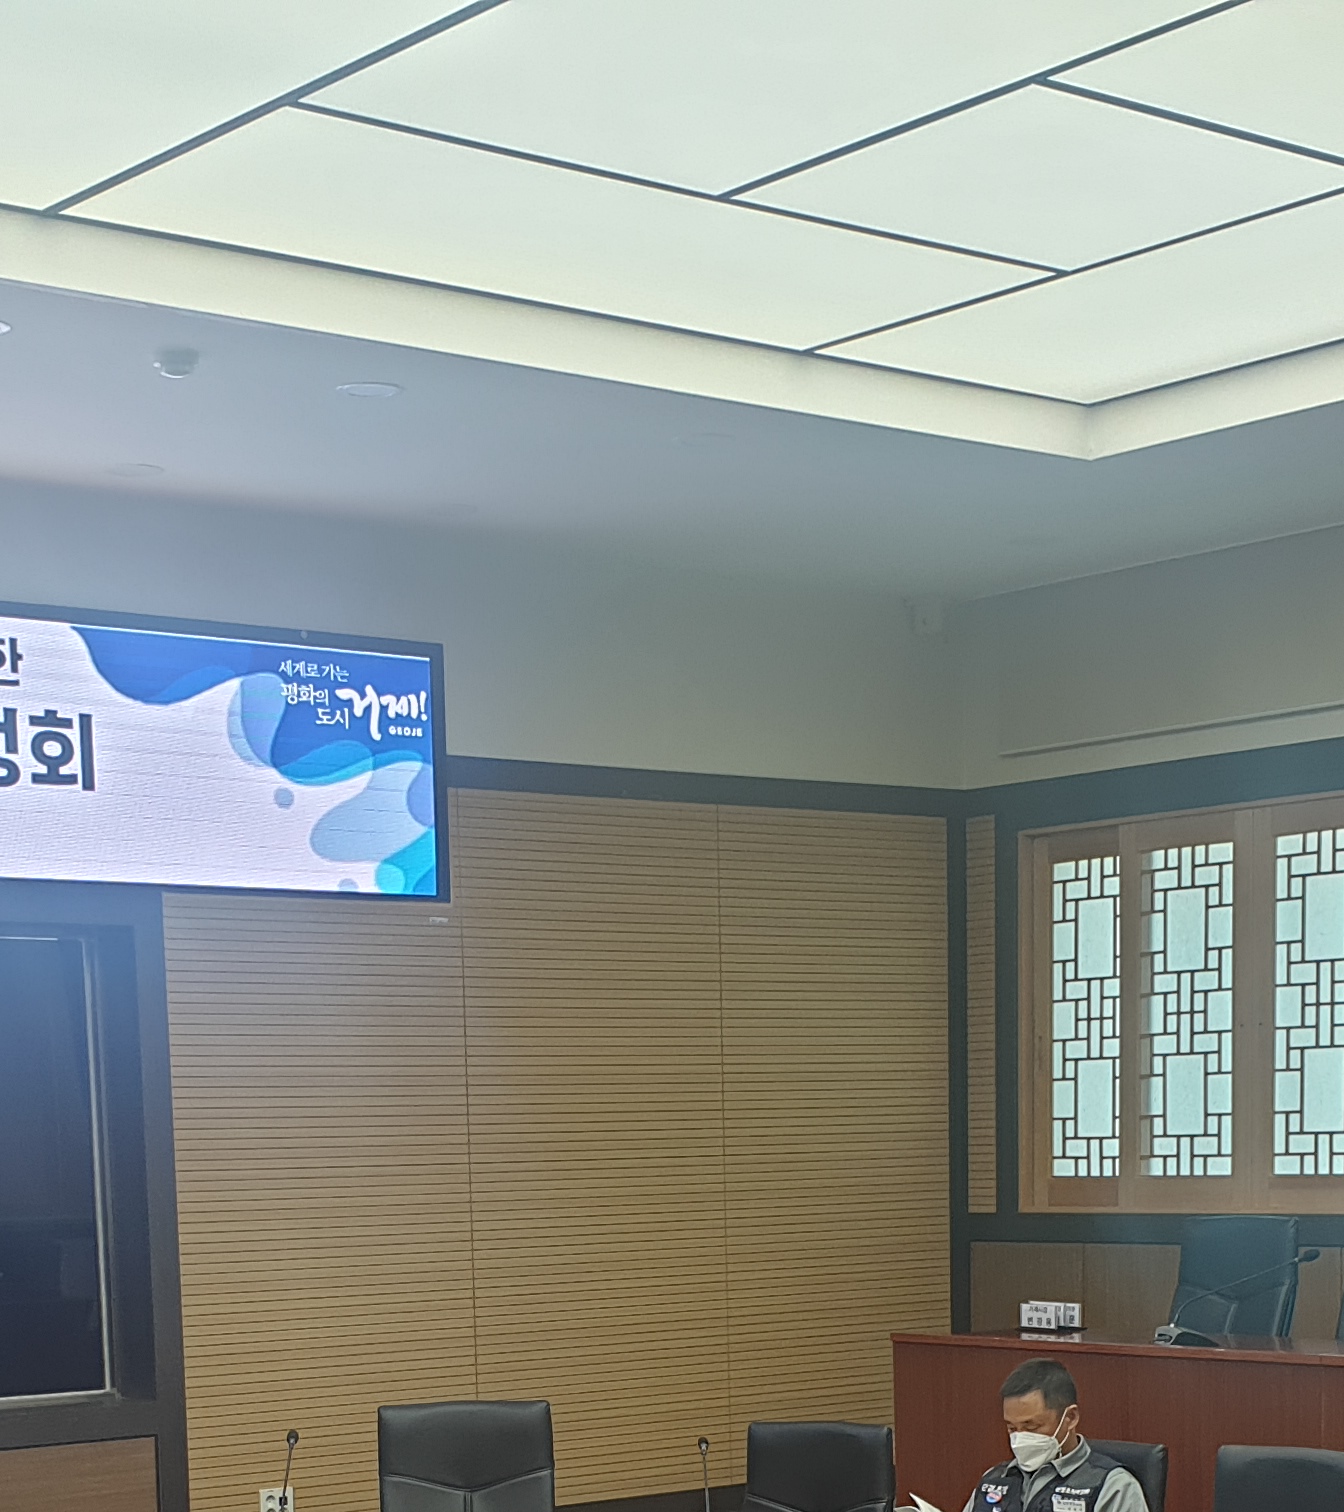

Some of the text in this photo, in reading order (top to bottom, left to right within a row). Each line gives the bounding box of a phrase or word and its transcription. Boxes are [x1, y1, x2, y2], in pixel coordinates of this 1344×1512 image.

[278, 659, 350, 683] 세계로 가는
[280, 682, 329, 706] 평화의
[315, 707, 349, 730] 도시
[388, 725, 423, 737] GEOJE
